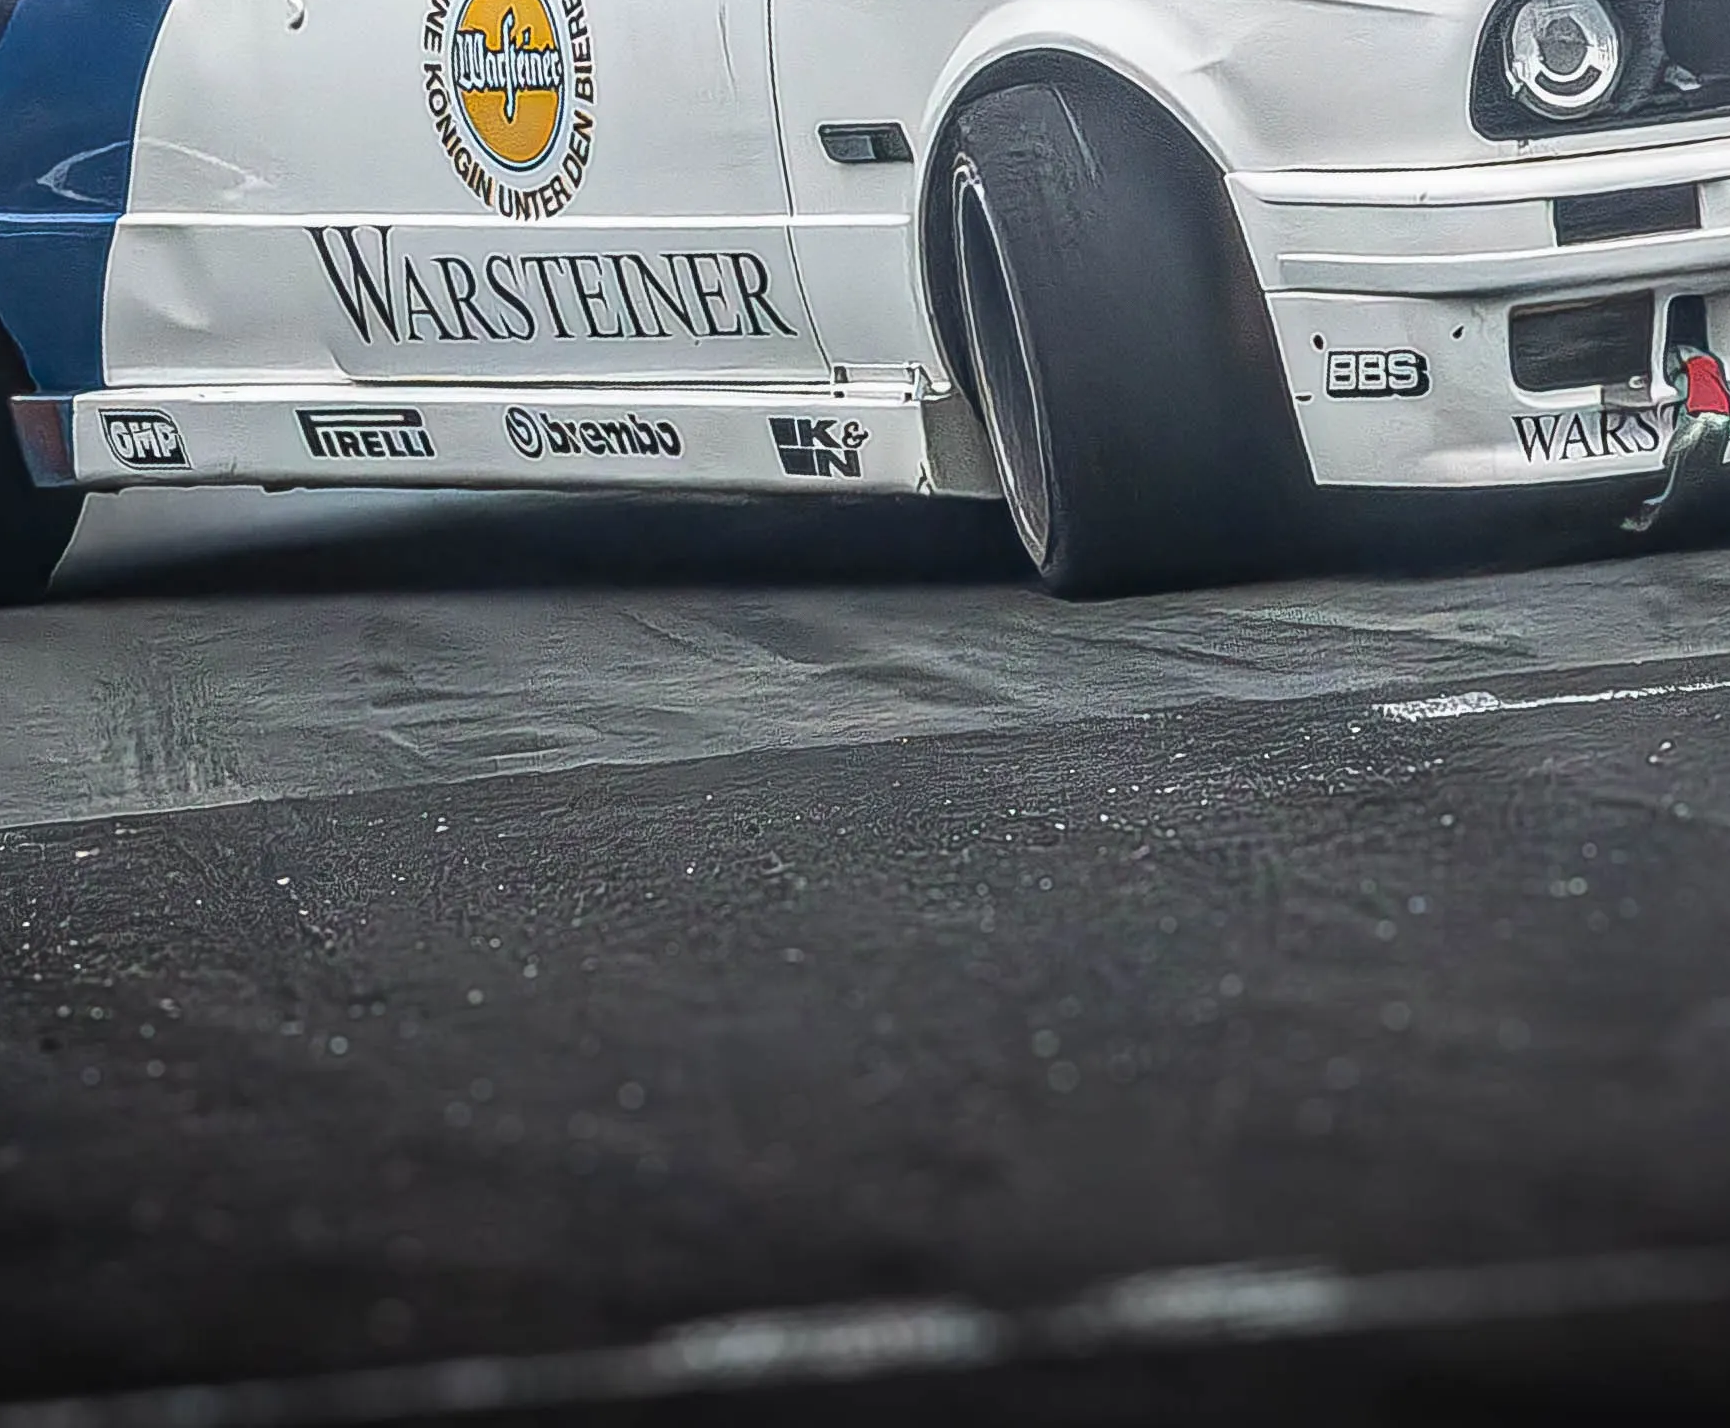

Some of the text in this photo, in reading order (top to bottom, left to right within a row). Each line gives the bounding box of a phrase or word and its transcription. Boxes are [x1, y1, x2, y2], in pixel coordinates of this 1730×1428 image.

[423, 62, 495, 207] KÖNIGIN
[498, 175, 572, 222] UNTER
[561, 110, 595, 191] DEN
[304, 224, 800, 345] WARSTEINER
[1326, 350, 1430, 398] BBS
[295, 407, 438, 460] PIRELLI
[539, 411, 684, 458] brembo
